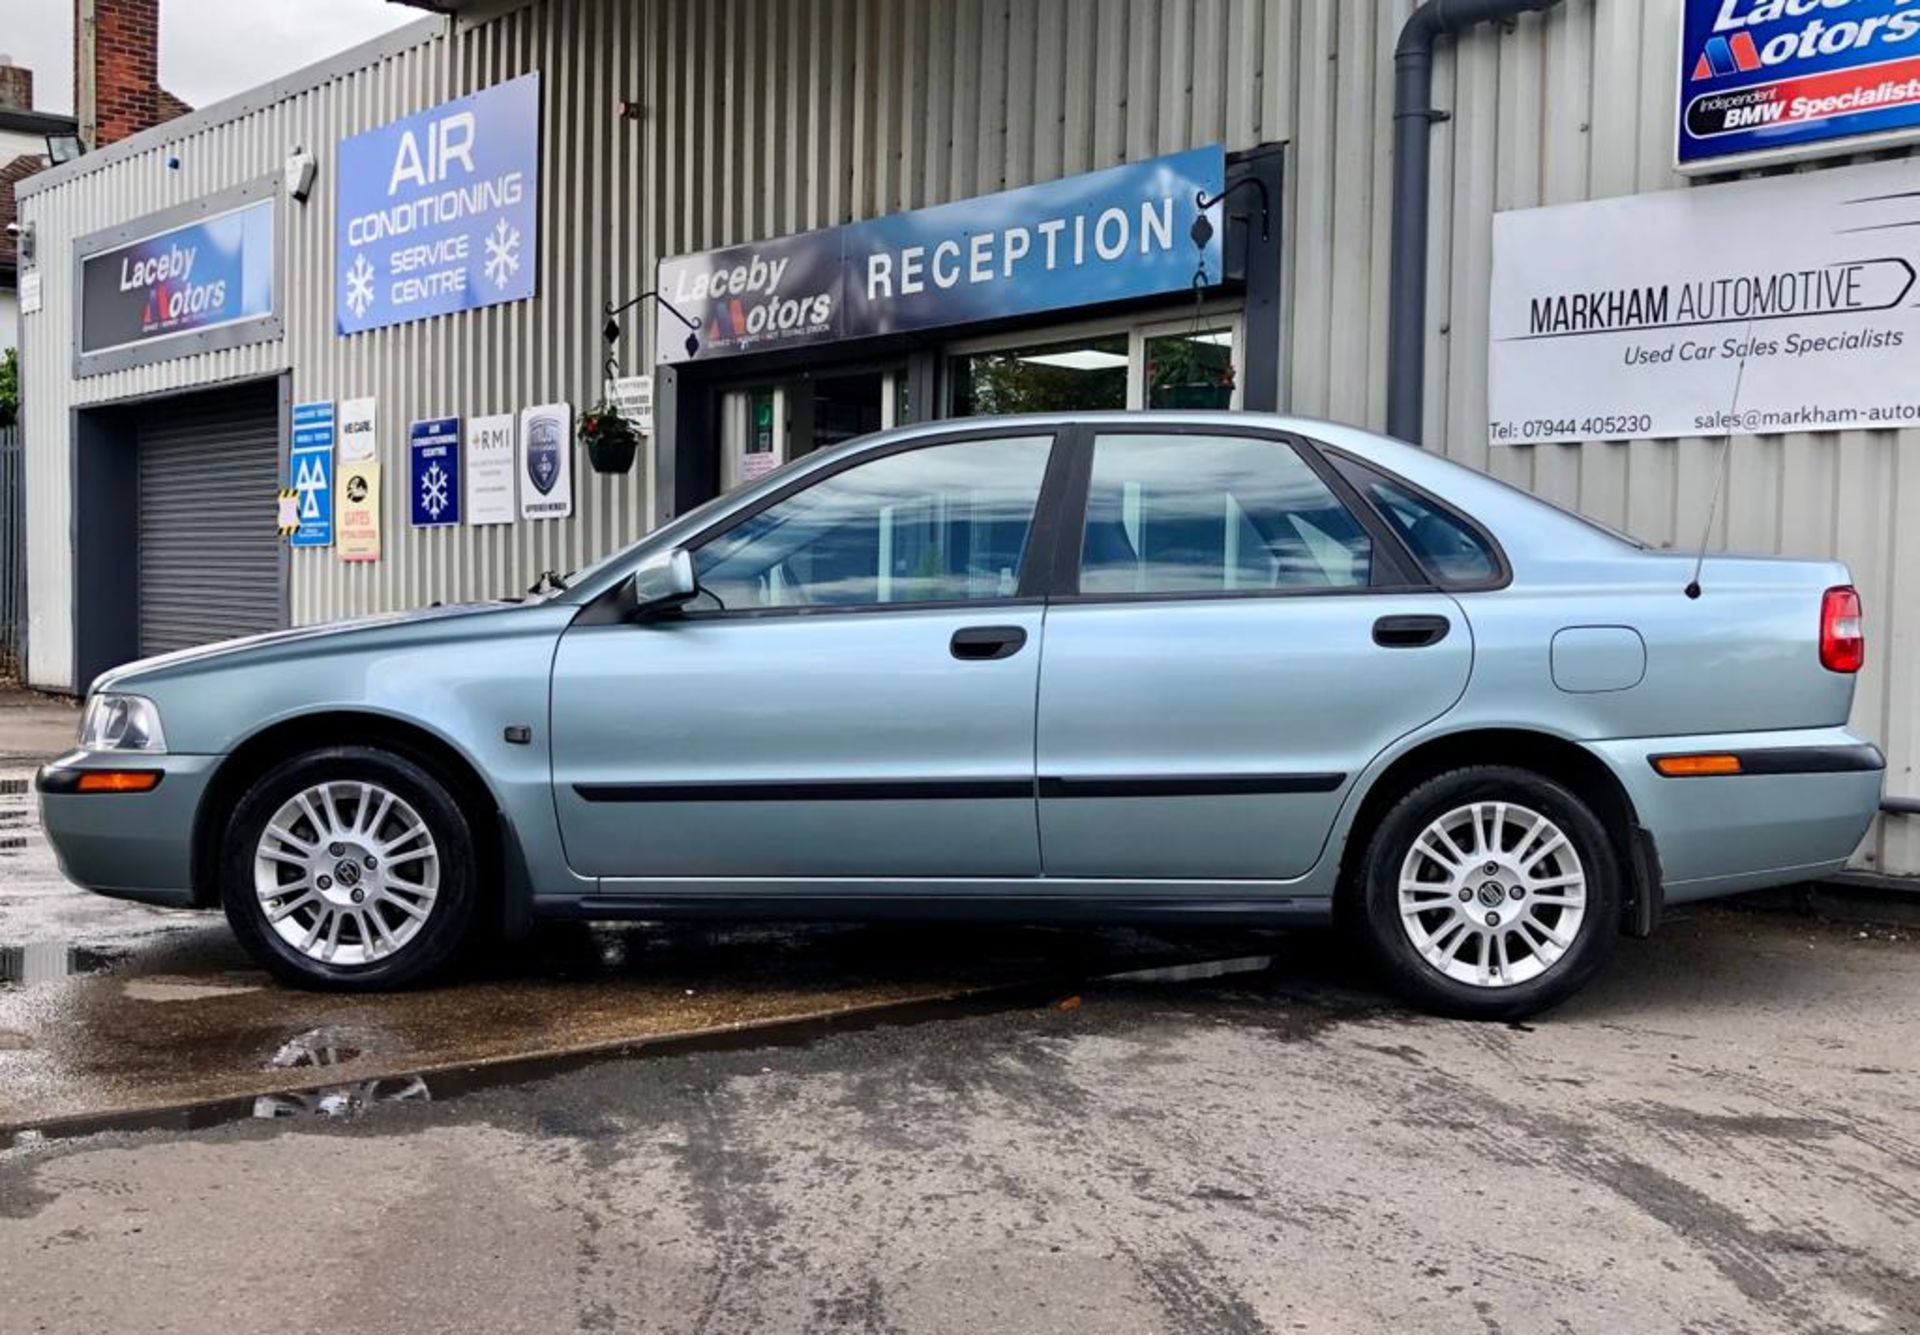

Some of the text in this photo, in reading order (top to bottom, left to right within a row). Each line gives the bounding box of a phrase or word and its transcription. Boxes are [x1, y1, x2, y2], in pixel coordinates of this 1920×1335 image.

[1700, 87, 1778, 113] Independent
[1723, 79, 1920, 129] BMW Specialist
[387, 110, 476, 196] AIR
[348, 171, 523, 247] CONDITIONING
[119, 244, 196, 292] Laceby
[389, 234, 469, 275] SERVICE
[867, 197, 1173, 301] RECEPTION
[391, 267, 467, 305] CENTRE
[675, 254, 789, 304] Laceby
[1530, 266, 1864, 335] MARKHAM AUTOMOTIVE
[1624, 327, 1904, 366] Used Car Sales Specialists
[481, 429, 510, 450] RMI
[1490, 404, 1920, 439] Tel: 07944 405230 sales@markham-auto
